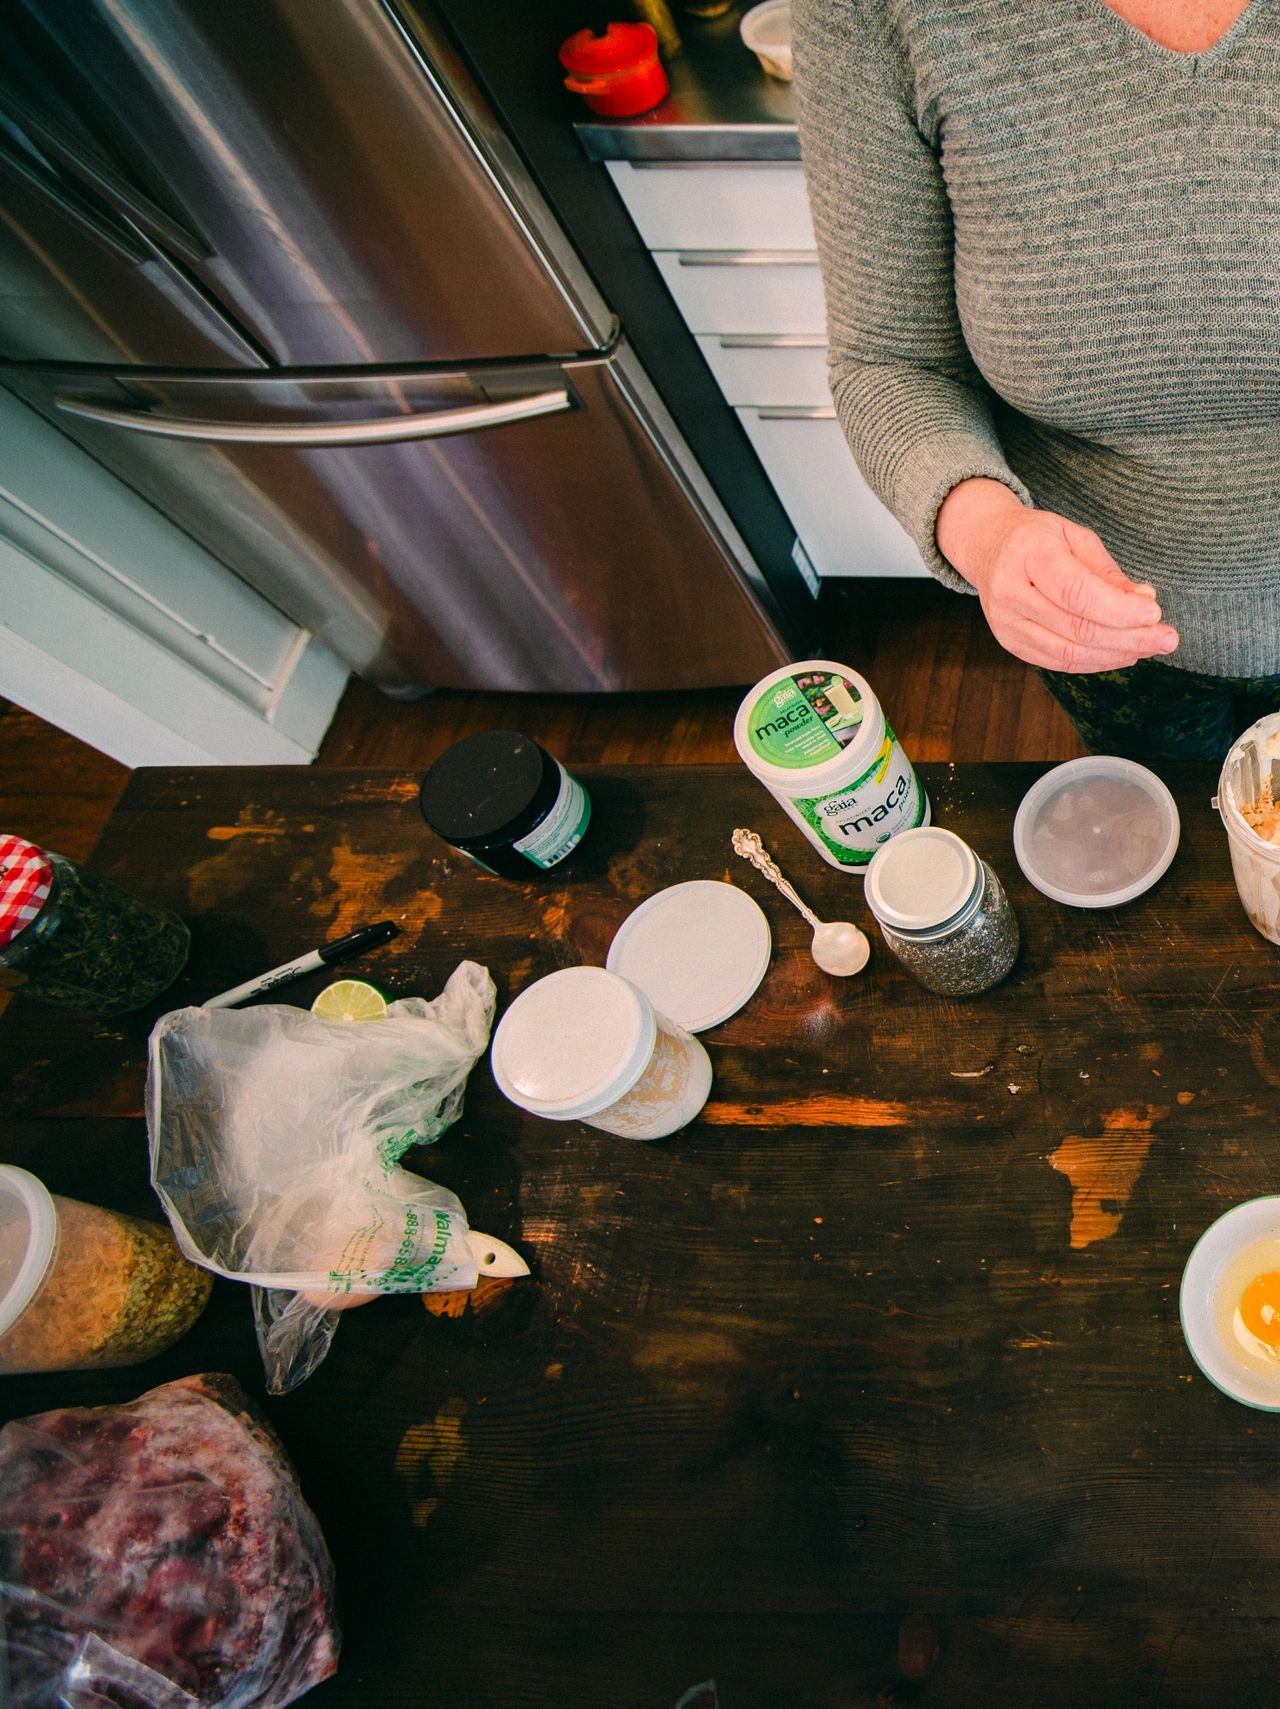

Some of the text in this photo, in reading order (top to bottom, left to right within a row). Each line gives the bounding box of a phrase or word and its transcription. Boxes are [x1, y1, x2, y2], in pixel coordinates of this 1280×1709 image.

[755, 704, 810, 740] maca
[784, 716, 813, 738] powder
[823, 797, 857, 817] gaia
[838, 775, 906, 836] maca
